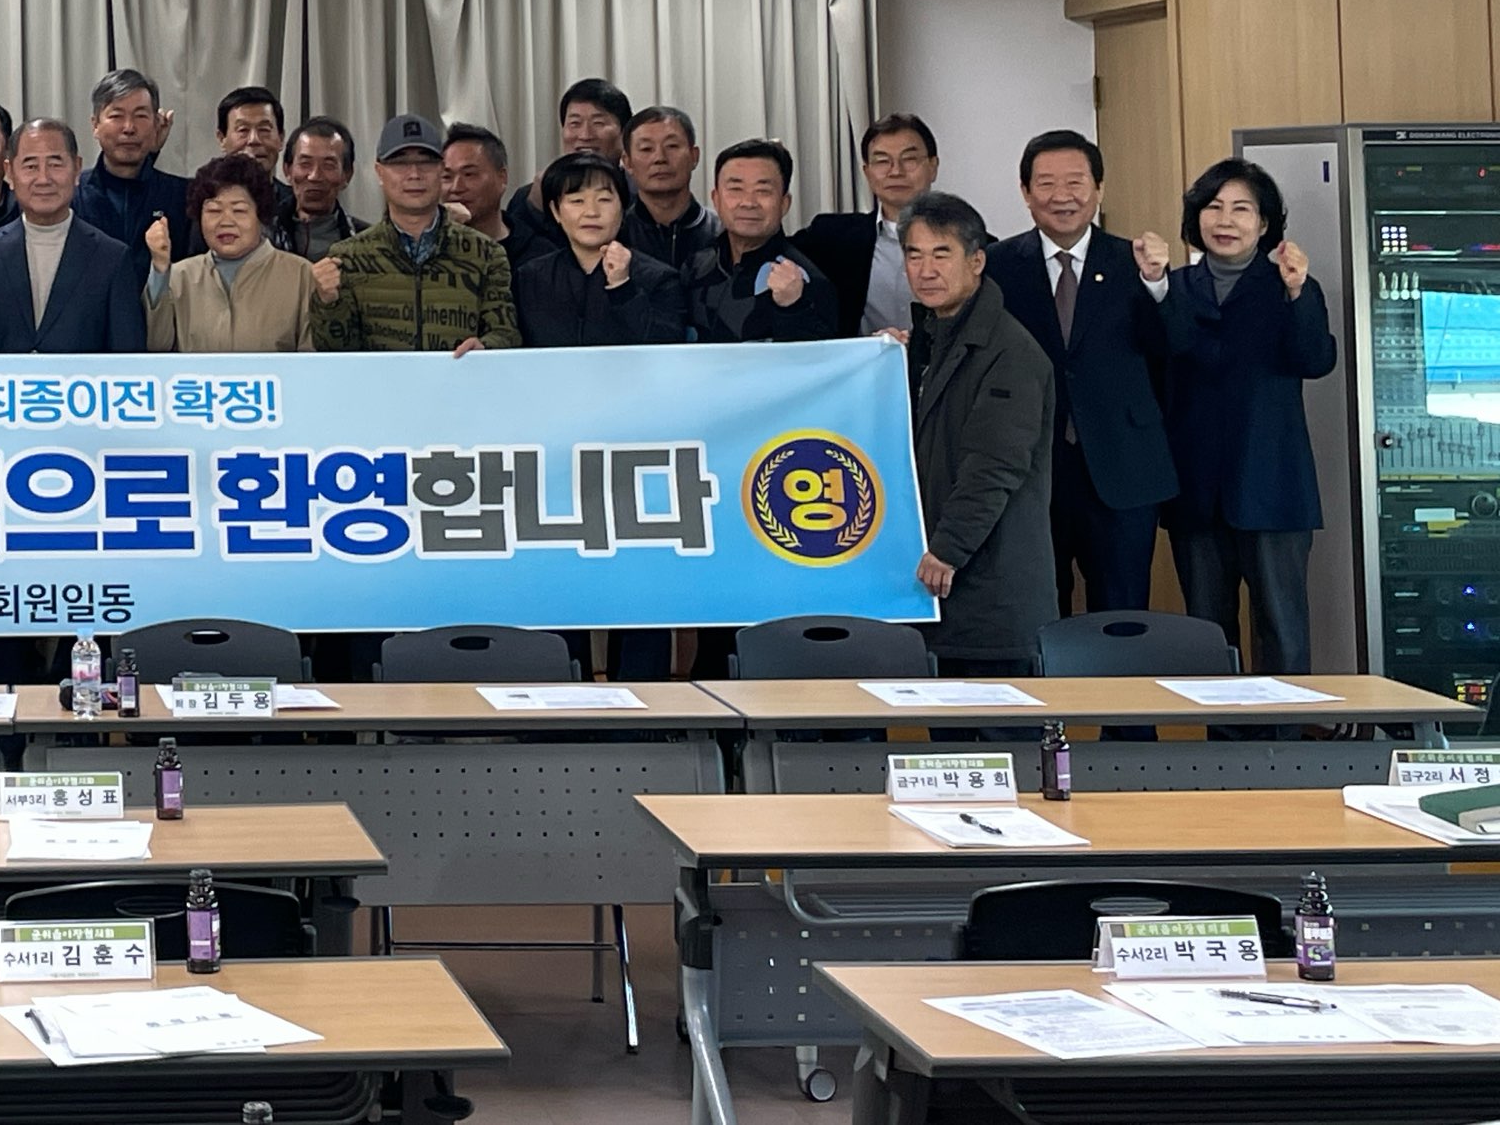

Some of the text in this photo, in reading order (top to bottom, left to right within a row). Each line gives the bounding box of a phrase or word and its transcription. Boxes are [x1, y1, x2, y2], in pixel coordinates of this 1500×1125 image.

[173, 378, 276, 425] 확정!
[216, 446, 711, 556] 환영합니다
[782, 467, 846, 532] 영
[3, 951, 54, 968] 수서1리
[1116, 946, 1169, 963] 수서2리
